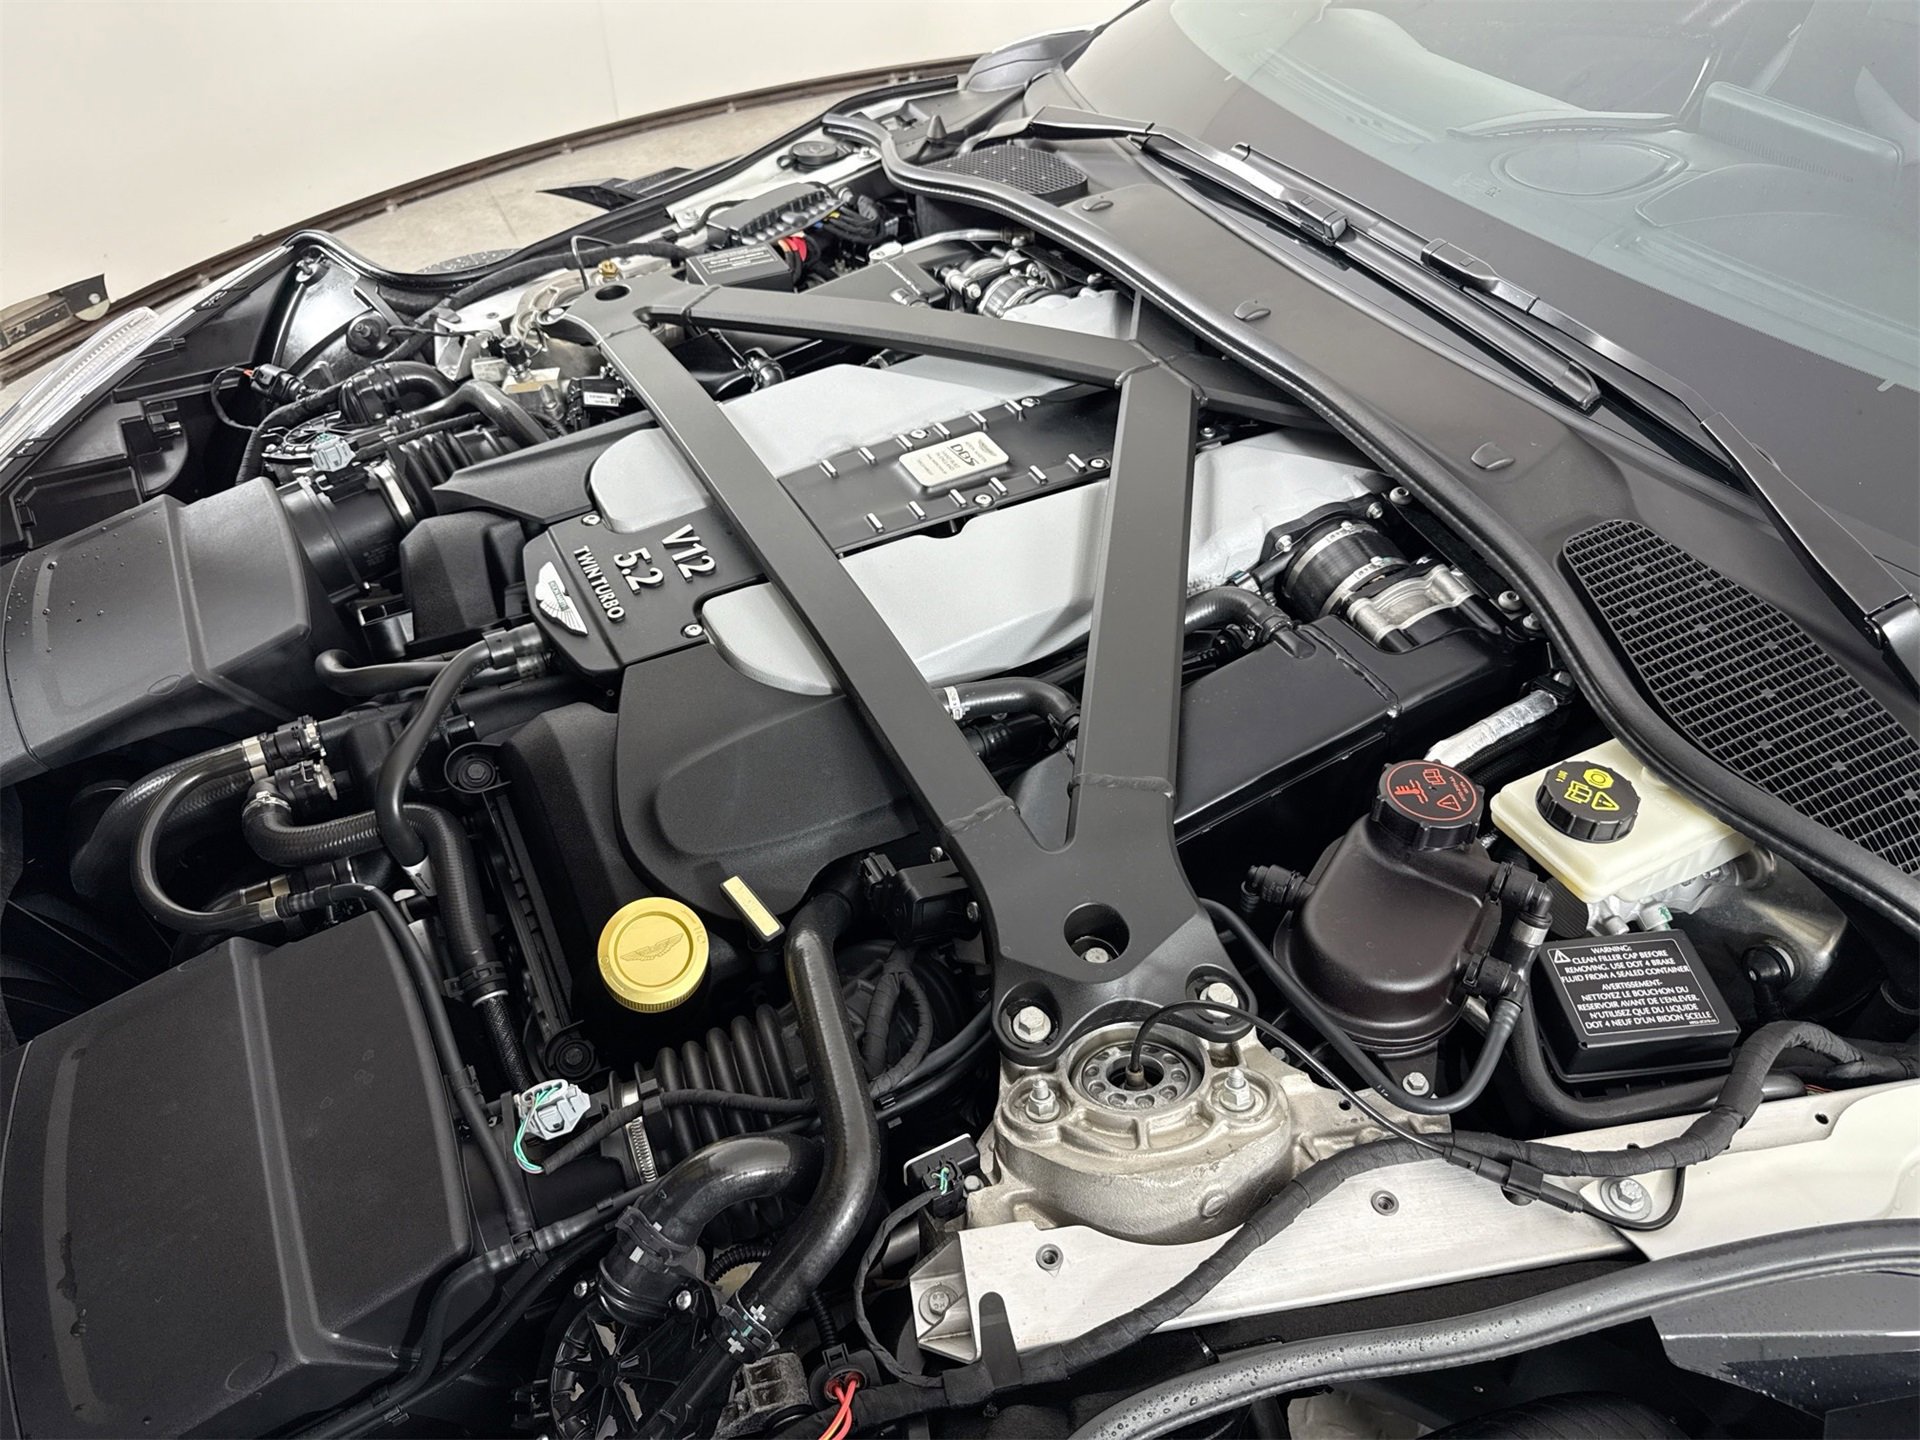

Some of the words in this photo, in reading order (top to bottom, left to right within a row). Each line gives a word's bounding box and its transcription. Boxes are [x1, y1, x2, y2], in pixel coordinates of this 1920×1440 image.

[661, 523, 717, 583] V12
[613, 547, 665, 596] 5.2
[573, 545, 603, 579] TWIN
[591, 576, 625, 619] TURBO
[1572, 956, 1598, 964] CLEAN
[1598, 954, 1622, 962] FILLER
[1639, 950, 1669, 959] BEFORE
[1626, 960, 1643, 968] DOT
[1651, 957, 1676, 966] BRAKE
[1560, 975, 1584, 983] FLUID
[1585, 972, 1609, 980] FROM
[1616, 969, 1644, 978] SEALED
[1581, 991, 1621, 1001] NETTOYEZ
[1631, 986, 1675, 997] BOUCHON
[1577, 1001, 1619, 1011] RESERVOIR
[1620, 998, 1646, 1007] AVANT
[1589, 1009, 1632, 1019] N'UTILISEZ
[1632, 1007, 1651, 1016] QUE
[1665, 1003, 1699, 1013] LIQUIDE
[1585, 1021, 1603, 1029] DOT
[1611, 1018, 1632, 1027] NEUF
[1633, 1016, 1656, 1025] D'UN
[1656, 1013, 1684, 1022] BIDON
[1684, 1011, 1712, 1020] SCELLE
